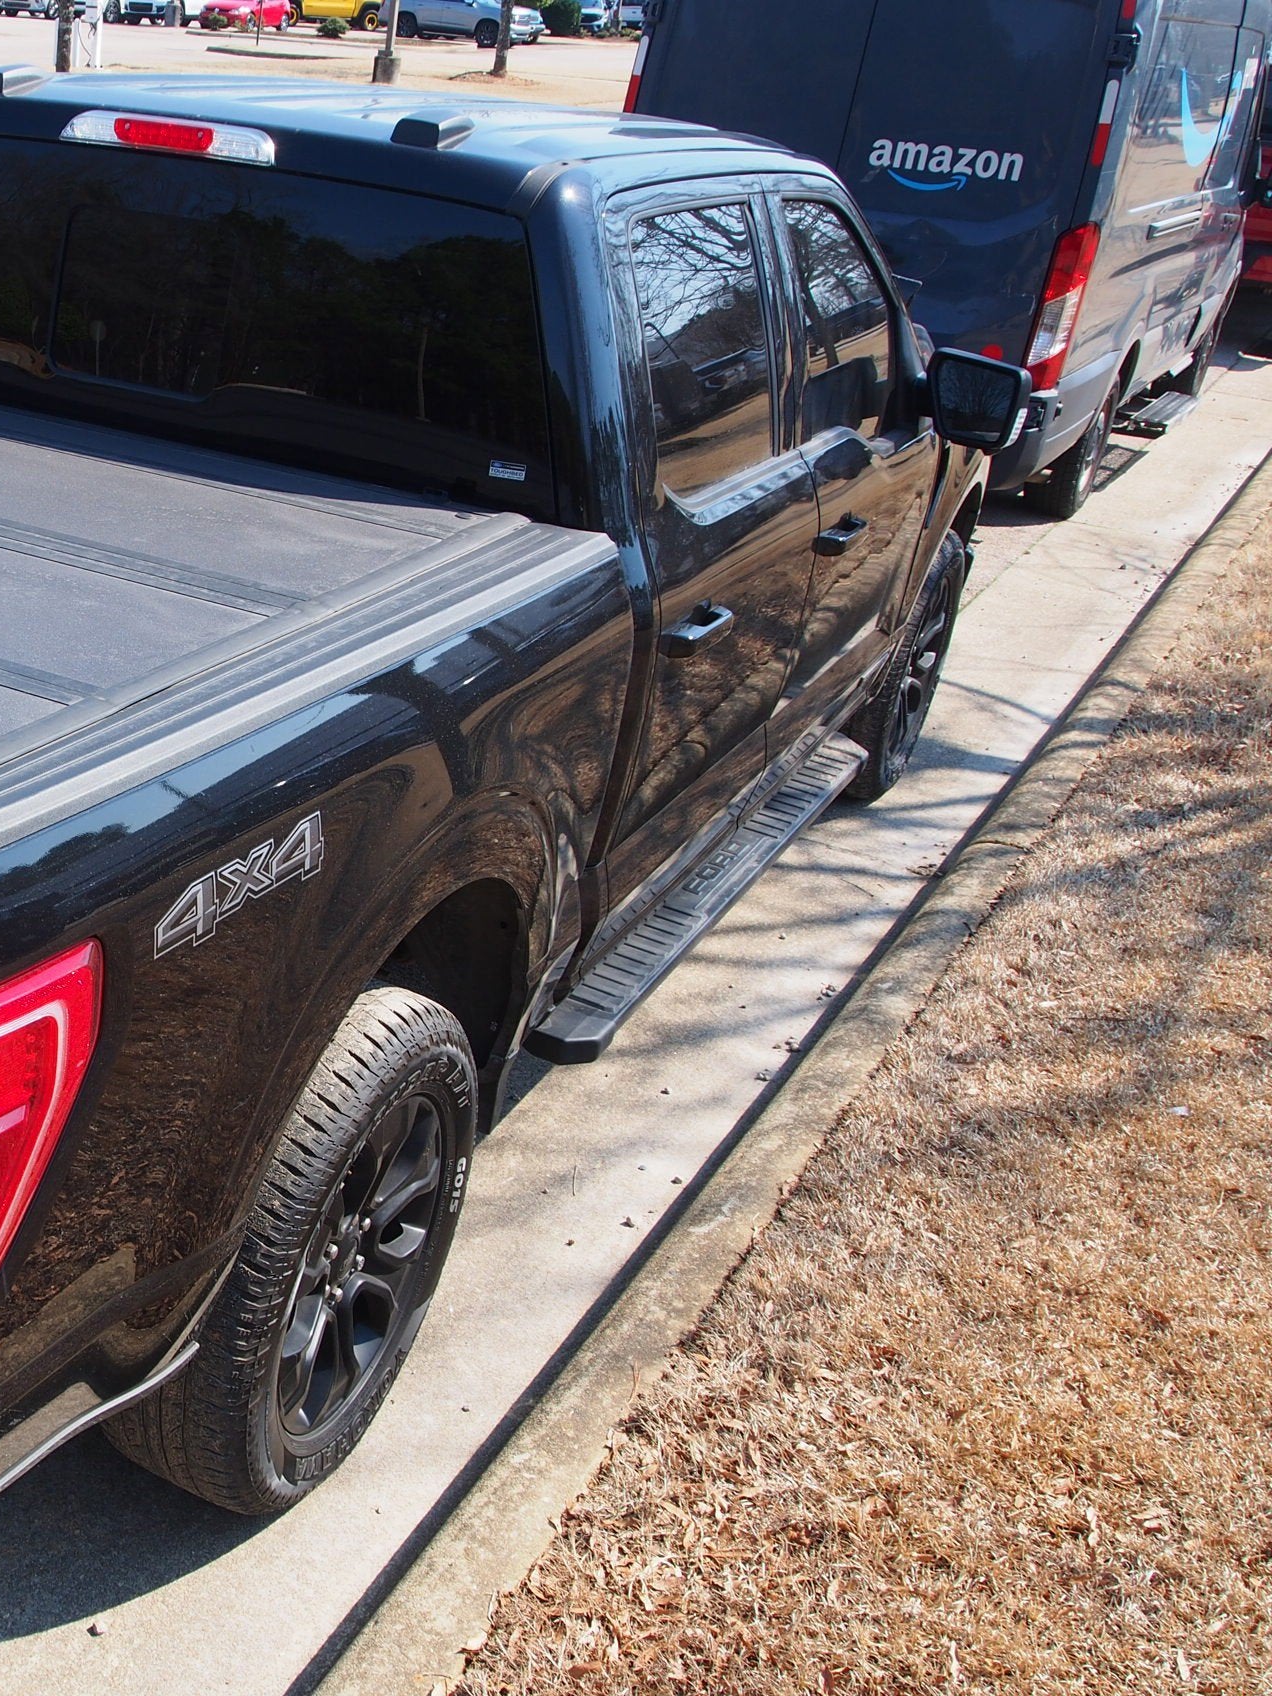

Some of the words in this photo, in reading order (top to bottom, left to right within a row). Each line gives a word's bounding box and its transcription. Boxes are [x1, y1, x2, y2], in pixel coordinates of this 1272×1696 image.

[868, 138, 1024, 182] amazon
[154, 810, 325, 960] 4x4
[449, 1156, 467, 1214] G015
[294, 1346, 407, 1480] YOKOHAMA
